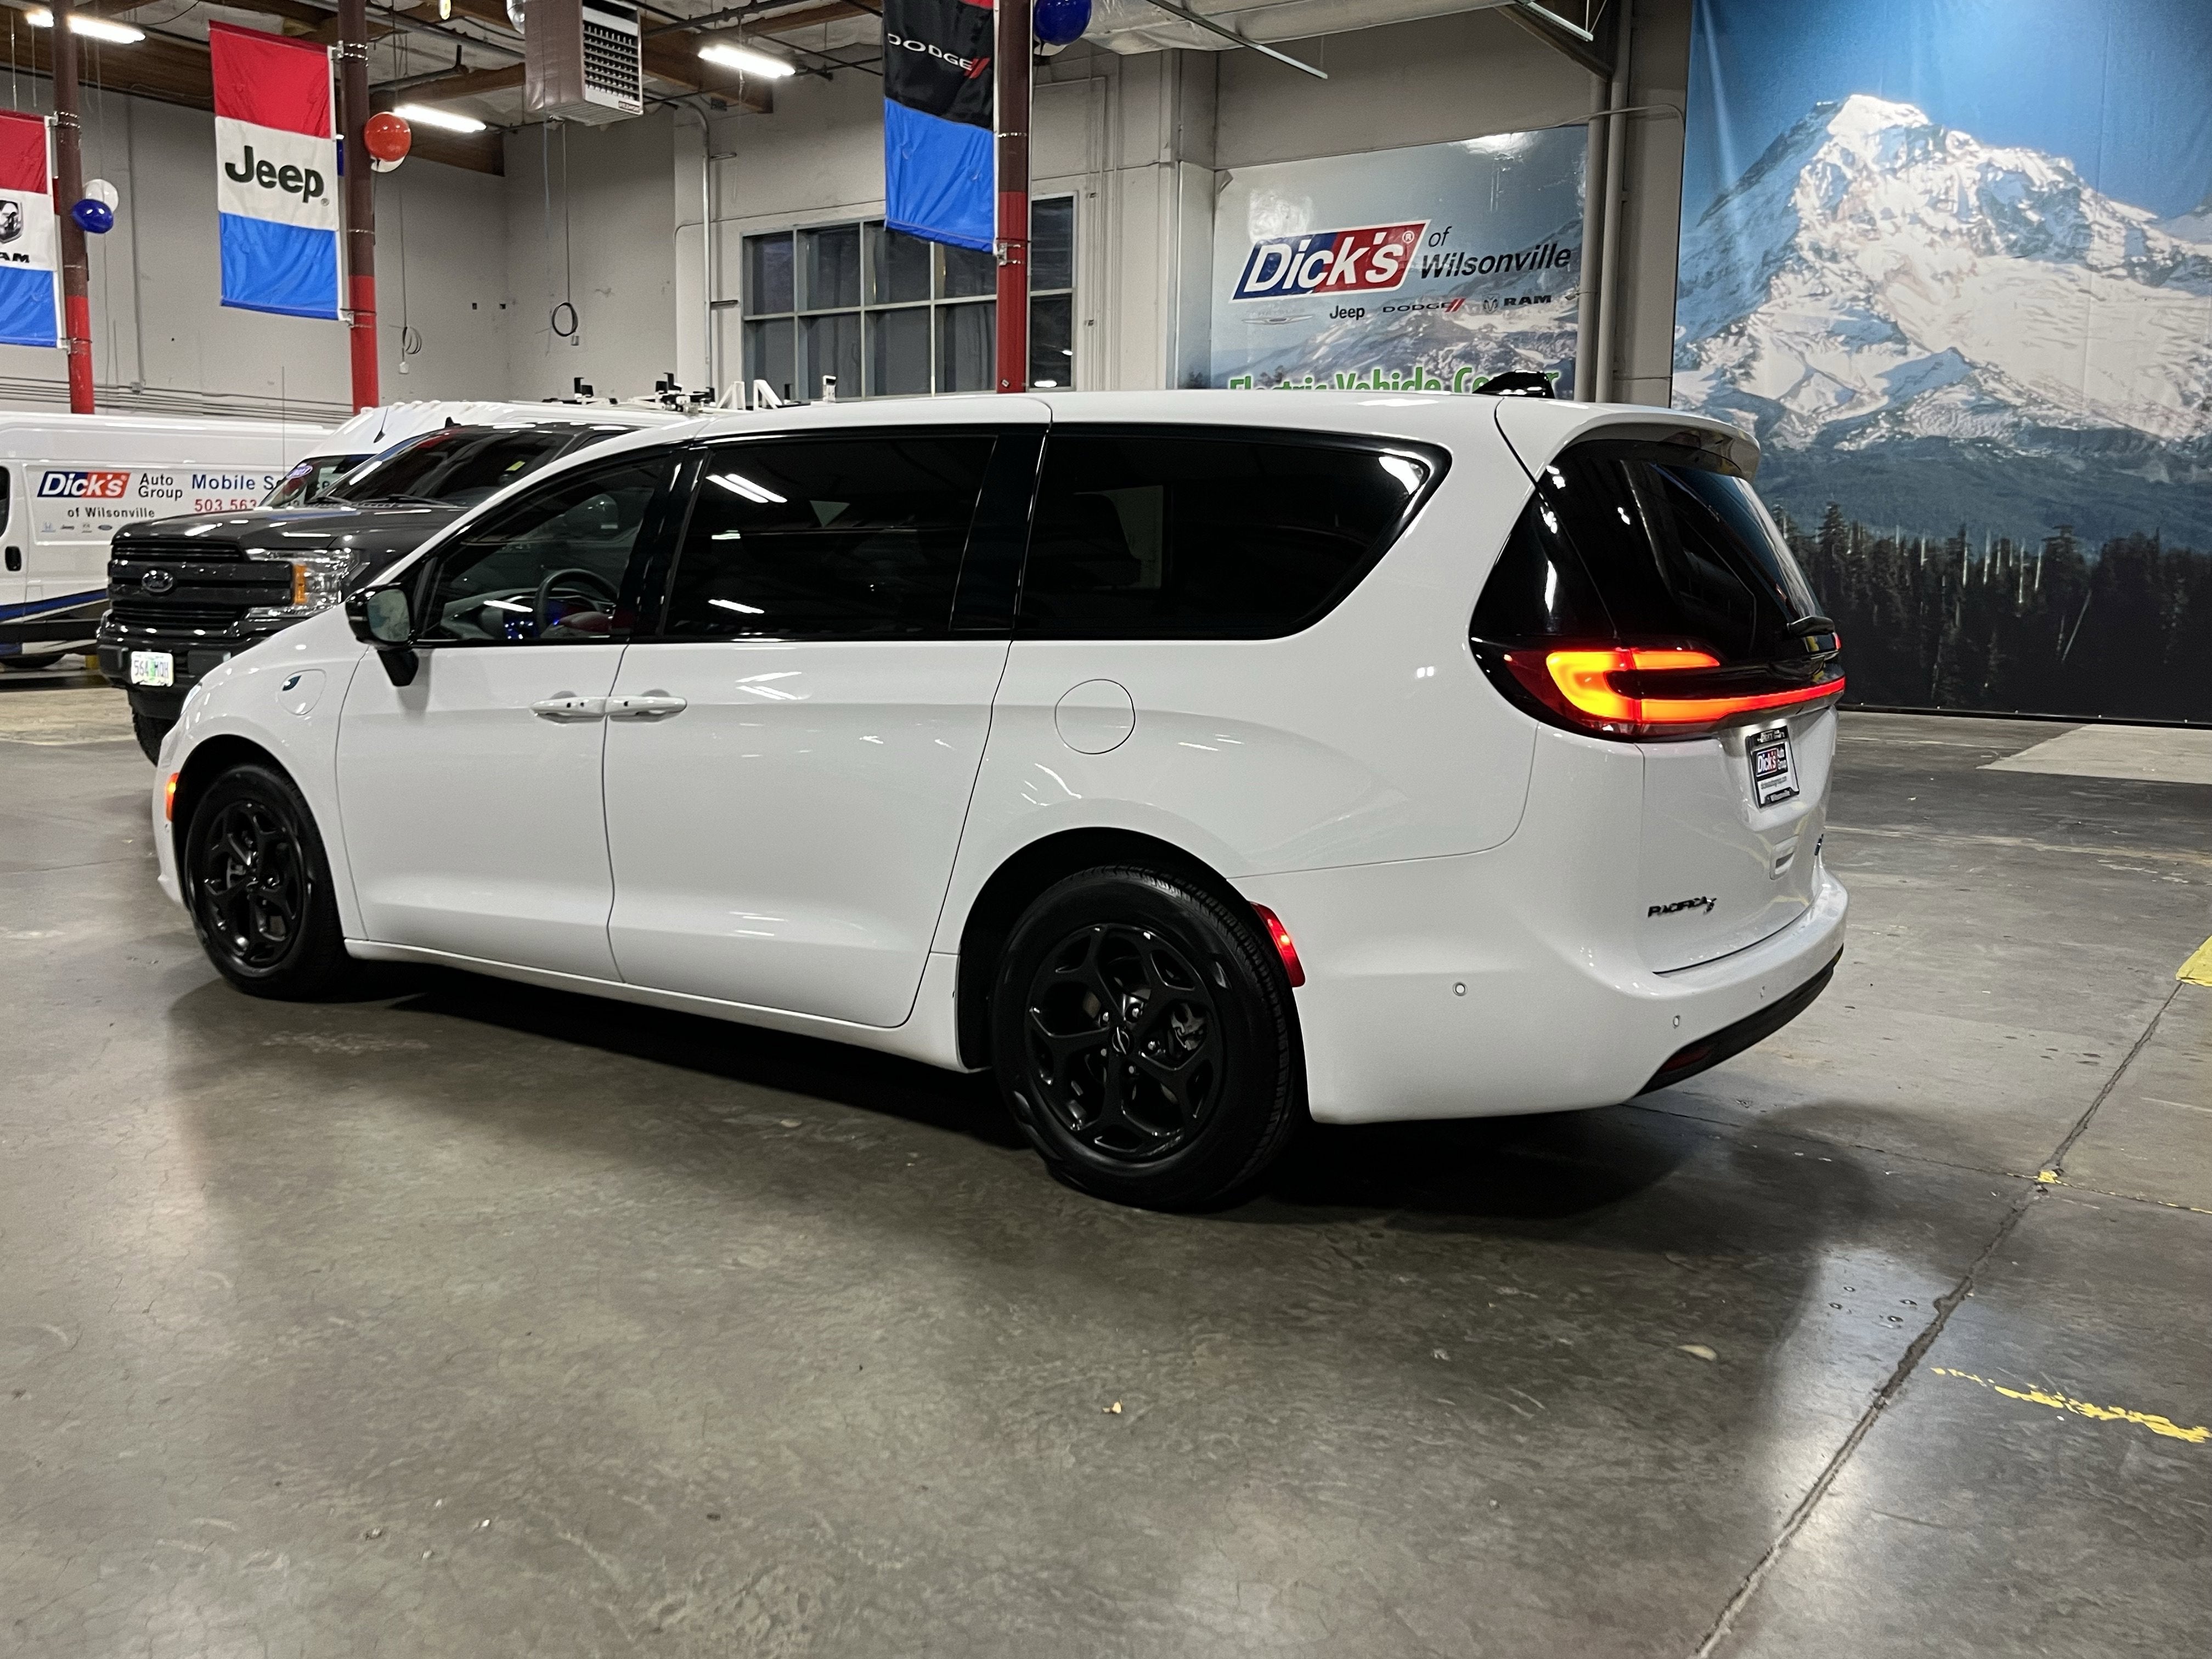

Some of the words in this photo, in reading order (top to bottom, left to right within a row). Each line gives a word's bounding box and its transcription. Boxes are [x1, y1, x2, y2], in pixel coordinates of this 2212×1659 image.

[887, 33, 973, 71] DODGE
[225, 145, 324, 204] Jeep
[1428, 226, 1452, 247] of
[0, 252, 30, 263] AM
[1243, 232, 1404, 292] Dick's
[1421, 243, 1571, 279] Wilsonville
[1330, 306, 1365, 320] Jeep
[1383, 302, 1453, 312] DODGE
[1504, 295, 1551, 306] RAM
[42, 473, 123, 496] Dick's
[139, 473, 173, 486] Auto
[192, 474, 256, 490] Mobile
[138, 486, 183, 501] Group
[67, 507, 80, 517] of
[85, 507, 155, 518] Wilsonville
[195, 499, 222, 511] 503
